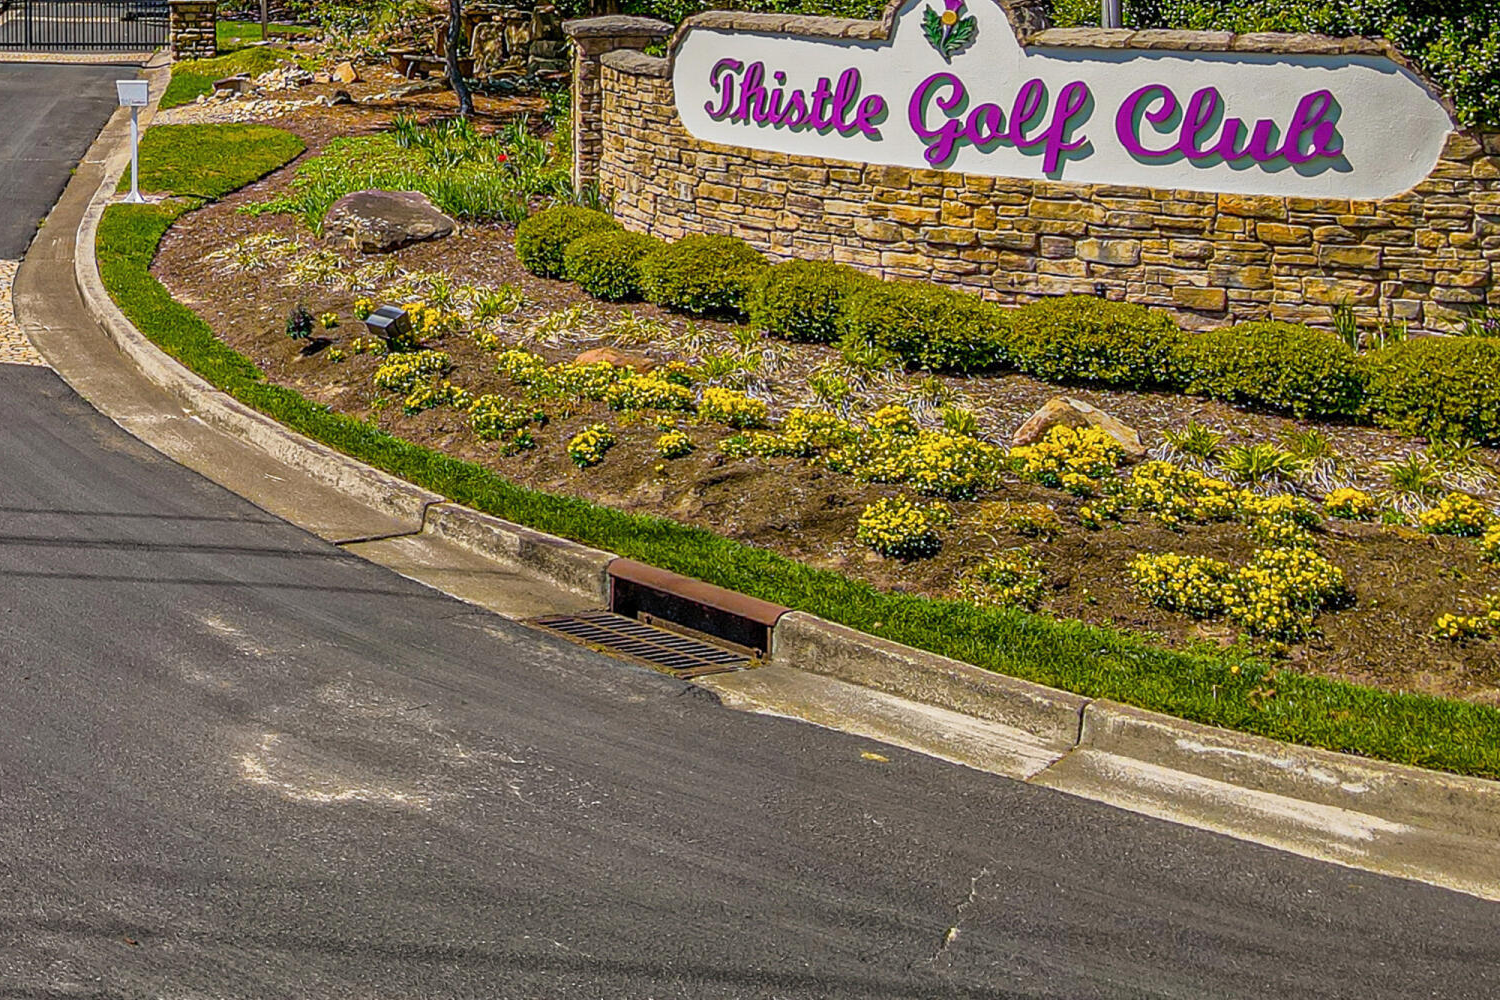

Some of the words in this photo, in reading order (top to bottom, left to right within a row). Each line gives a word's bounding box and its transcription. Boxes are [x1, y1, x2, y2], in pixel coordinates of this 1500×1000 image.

[704, 58, 884, 136] Thistle
[908, 72, 1088, 174] Golf
[1115, 84, 1342, 165] Club
